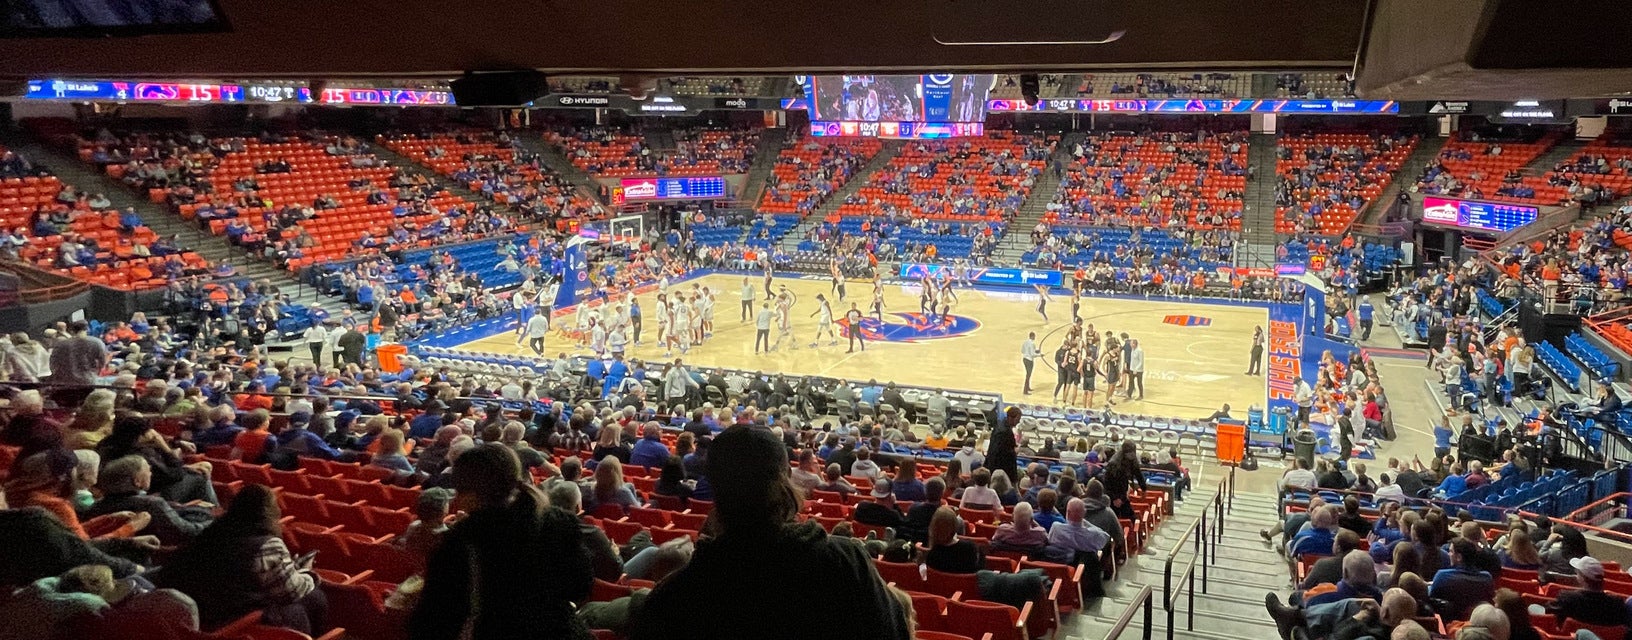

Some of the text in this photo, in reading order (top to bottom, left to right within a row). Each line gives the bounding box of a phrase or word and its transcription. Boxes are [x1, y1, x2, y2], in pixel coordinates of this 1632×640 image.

[118, 90, 127, 100] 4
[189, 84, 213, 101] 15
[251, 86, 281, 97] 10:47
[326, 88, 344, 103] 15
[1016, 100, 1028, 111] 15
[1050, 100, 1069, 108] 10:47
[1097, 100, 1111, 111] 15
[860, 122, 879, 132] 10:47
[1269, 319, 1302, 403] BOISE STATE
